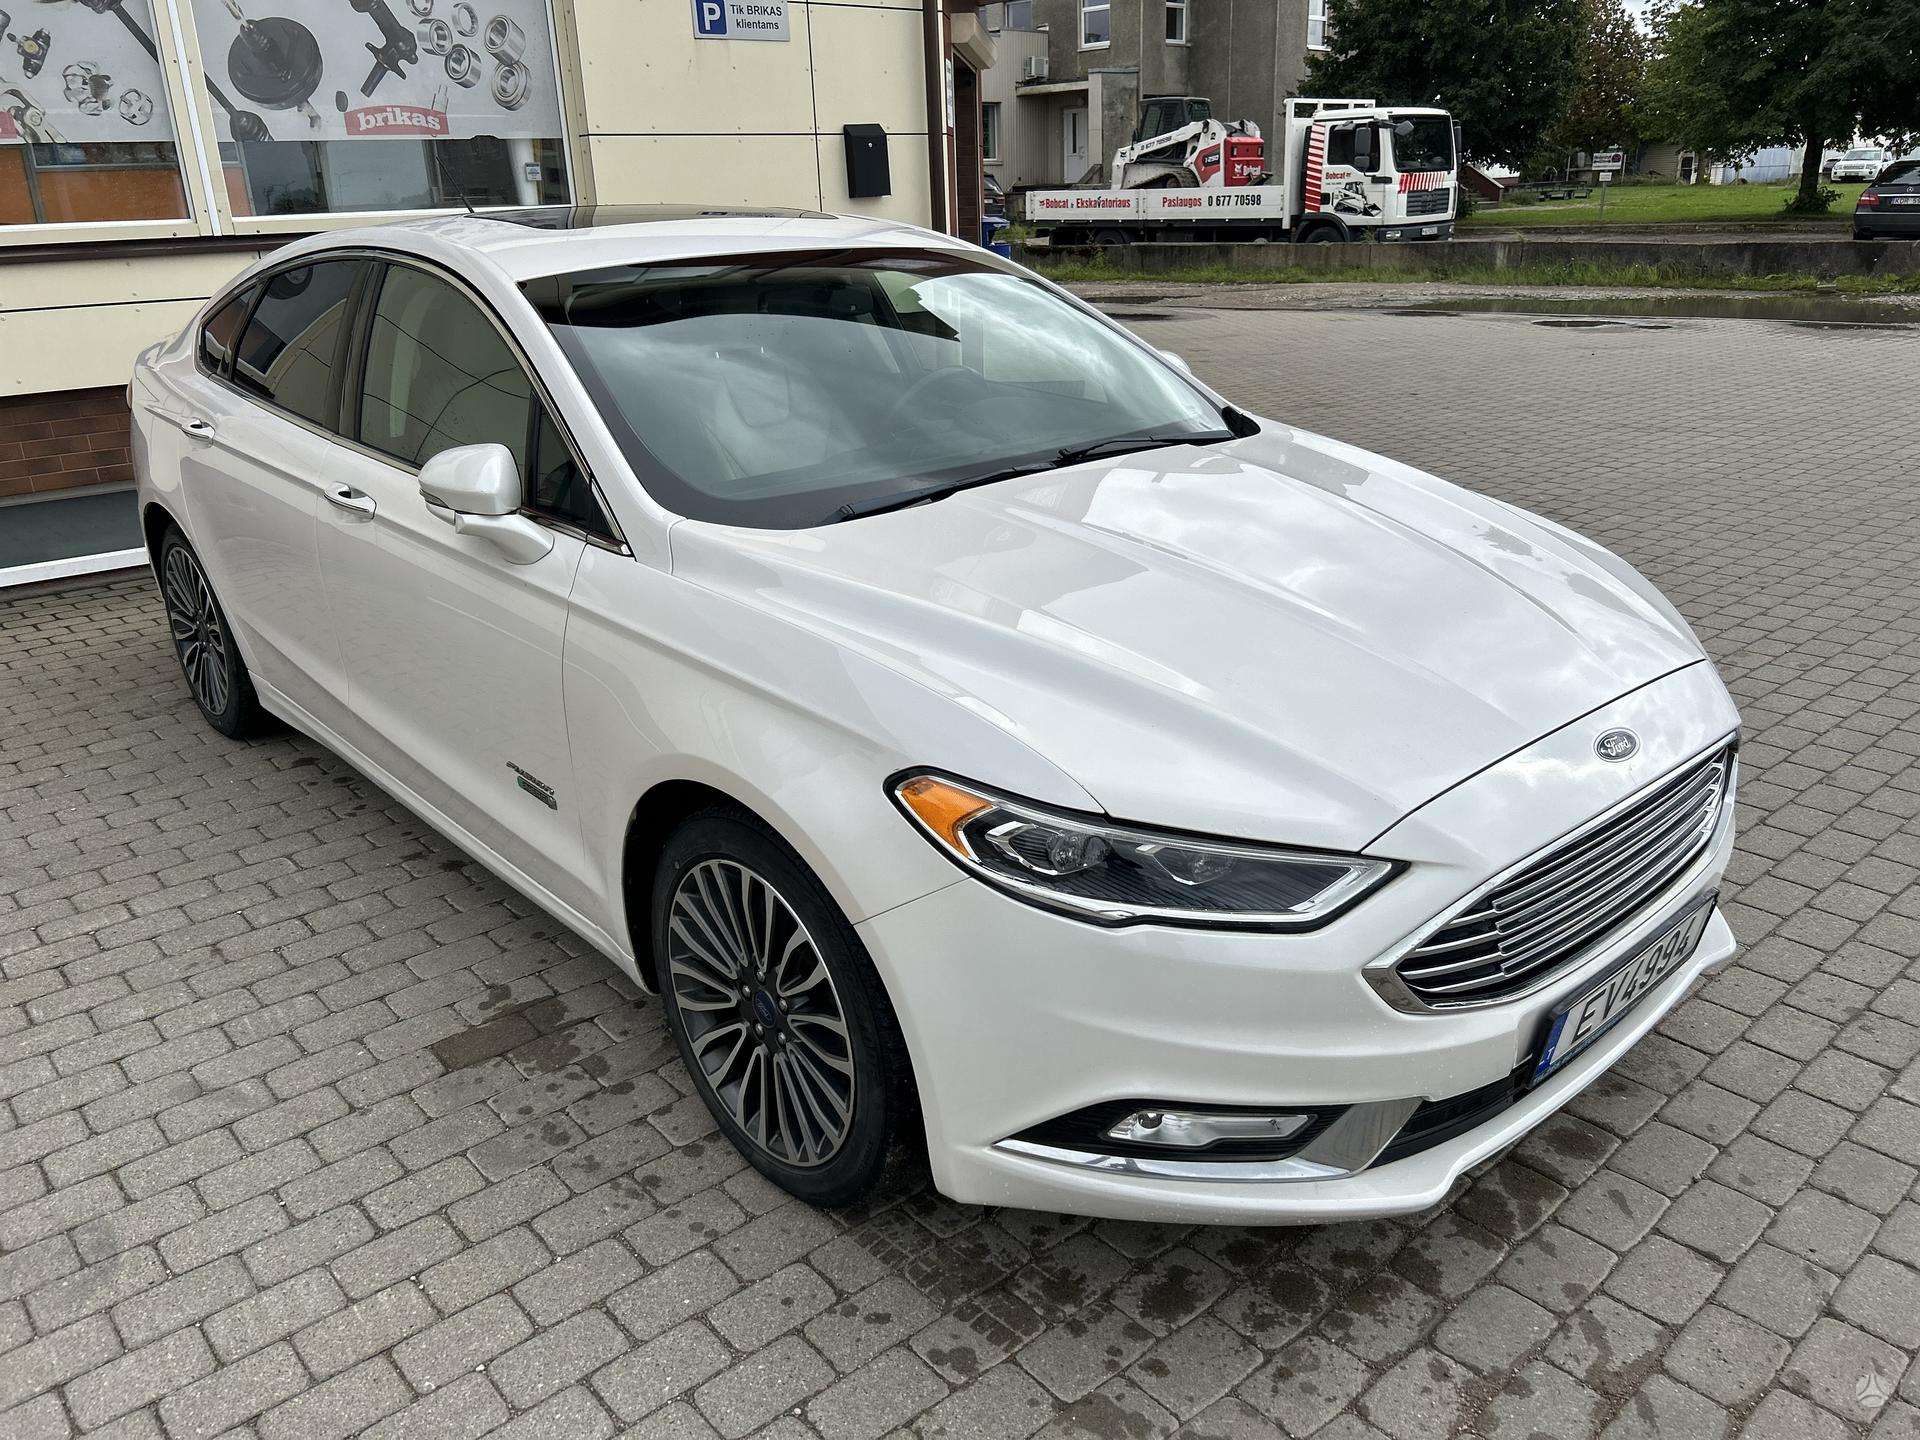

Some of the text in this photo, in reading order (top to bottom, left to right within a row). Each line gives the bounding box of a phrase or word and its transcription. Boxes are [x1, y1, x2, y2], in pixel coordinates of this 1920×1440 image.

[703, 2, 721, 31] P
[730, 4, 782, 16] Tik BRIKAS
[736, 19, 779, 30] klientams
[357, 107, 441, 131] brikas
[1162, 194, 1262, 208] Paslaugos 0 677 70598
[1603, 735, 1631, 757] Ford
[1571, 915, 1697, 1045] EV4994
